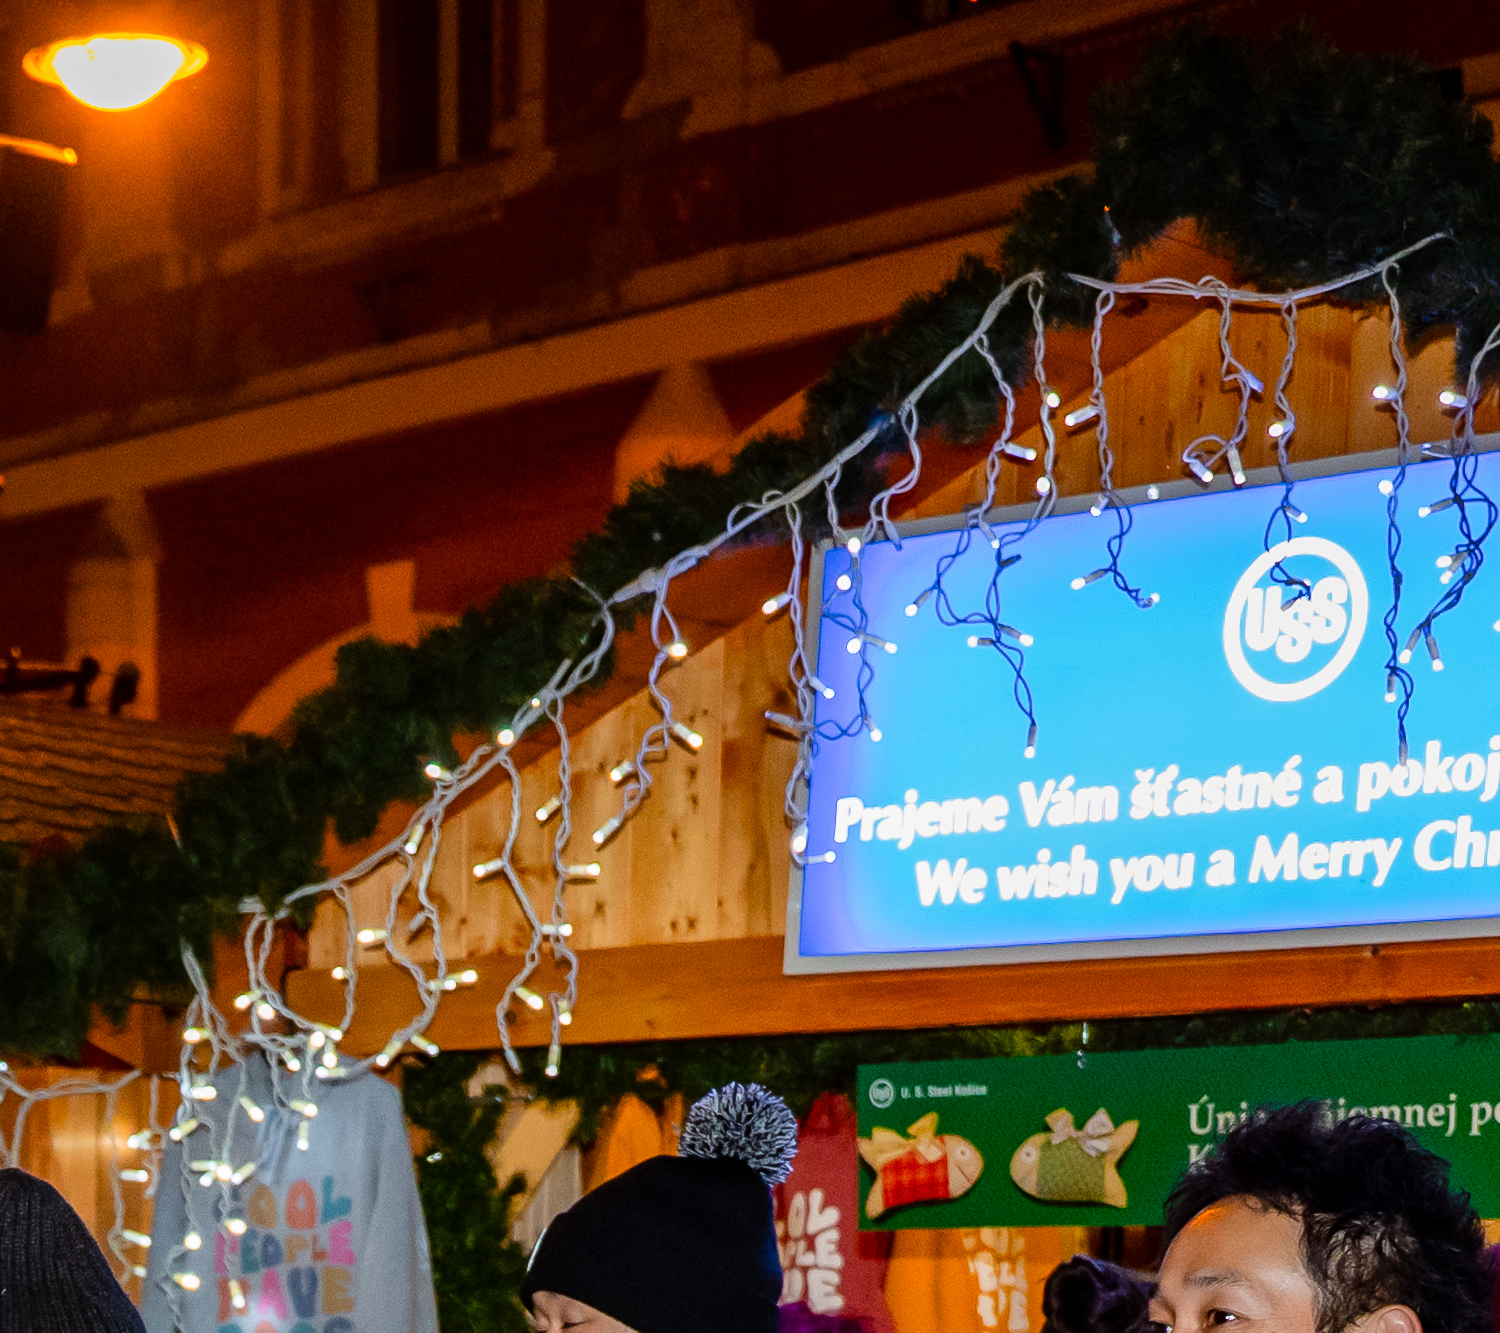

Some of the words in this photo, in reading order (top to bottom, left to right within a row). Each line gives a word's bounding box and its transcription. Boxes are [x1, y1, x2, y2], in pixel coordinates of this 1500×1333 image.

[1244, 576, 1348, 663] USS
[834, 789, 1008, 849] Prajeme
[1018, 774, 1118, 828] Vám
[1131, 755, 1302, 820] šťastné
[1315, 766, 1346, 802] a
[915, 856, 987, 906] We
[996, 846, 1097, 900] wish
[1110, 852, 1192, 904] you
[1206, 850, 1237, 885] a
[1248, 832, 1403, 888] Merry
[214, 1220, 356, 1275] PEOPLE
